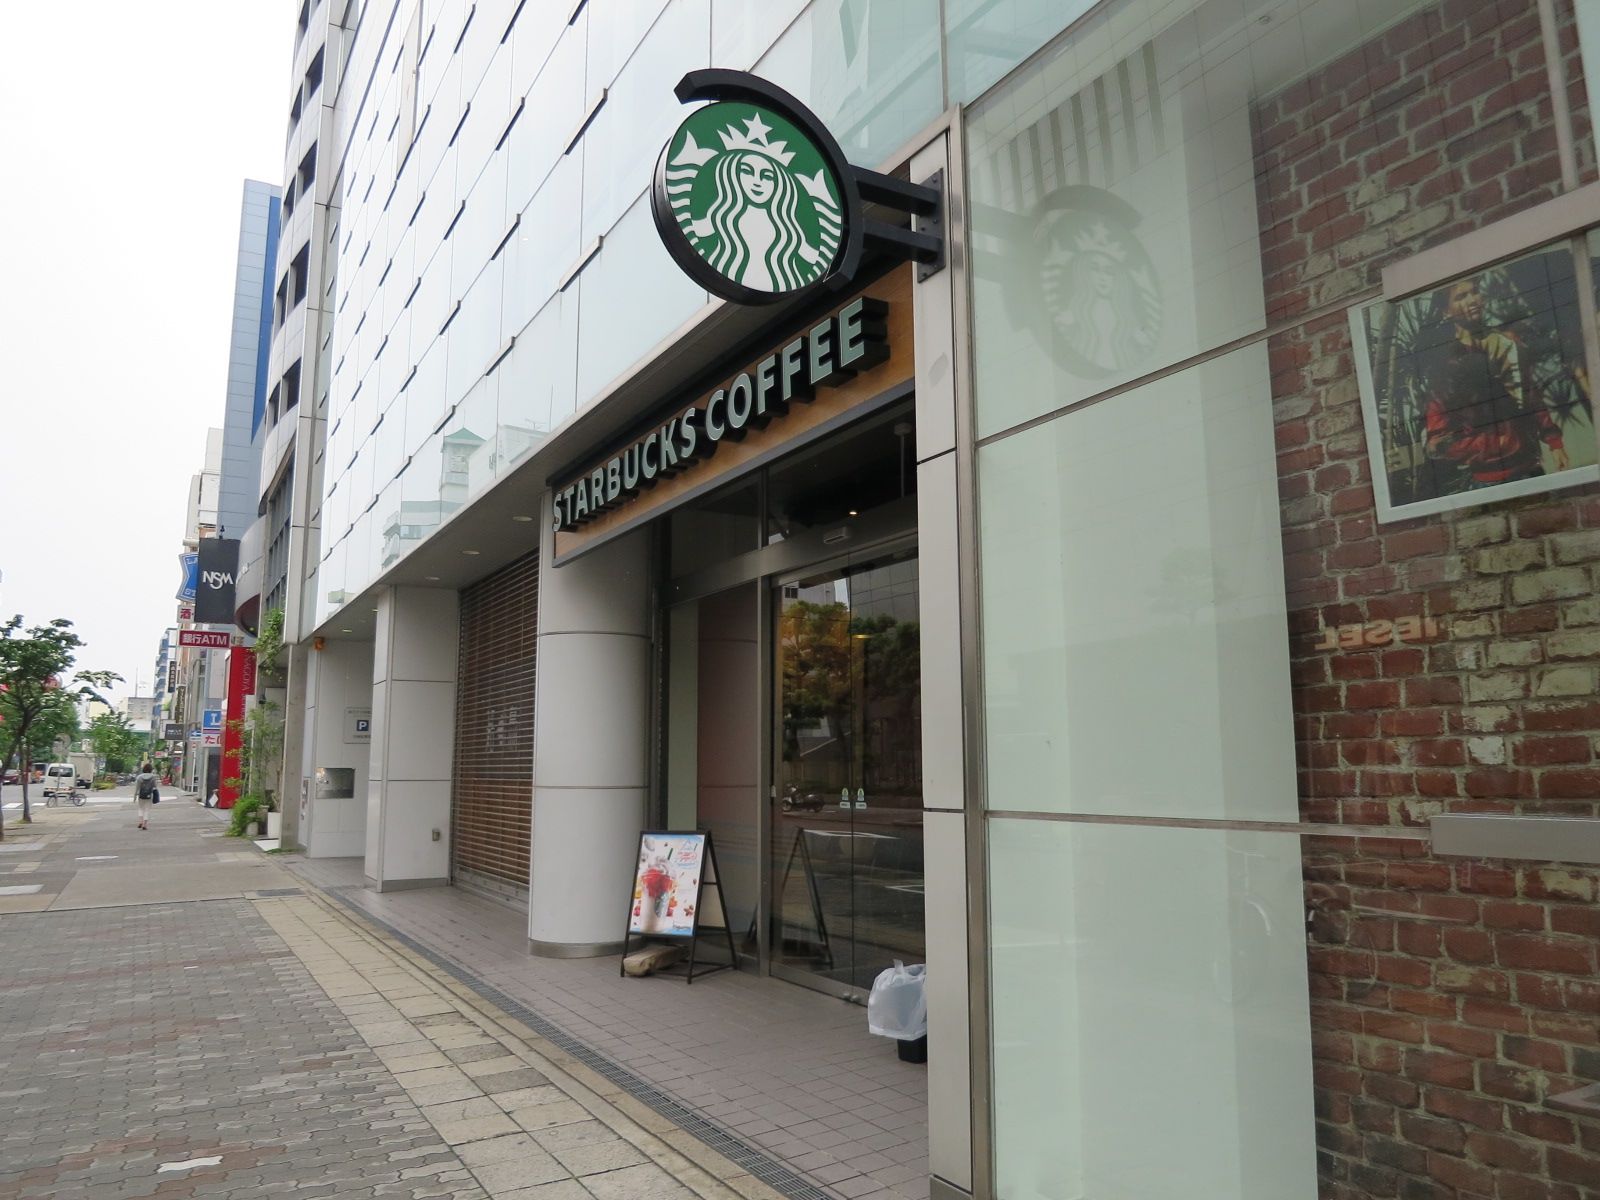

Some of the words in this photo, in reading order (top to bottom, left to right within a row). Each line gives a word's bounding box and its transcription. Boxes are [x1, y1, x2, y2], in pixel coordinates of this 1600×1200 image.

[552, 407, 697, 532] STARBUCKS
[705, 297, 866, 442] COFFEE
[202, 571, 233, 590] NSM
[182, 633, 228, 645] 銀行ATM
[359, 721, 368, 730] P
